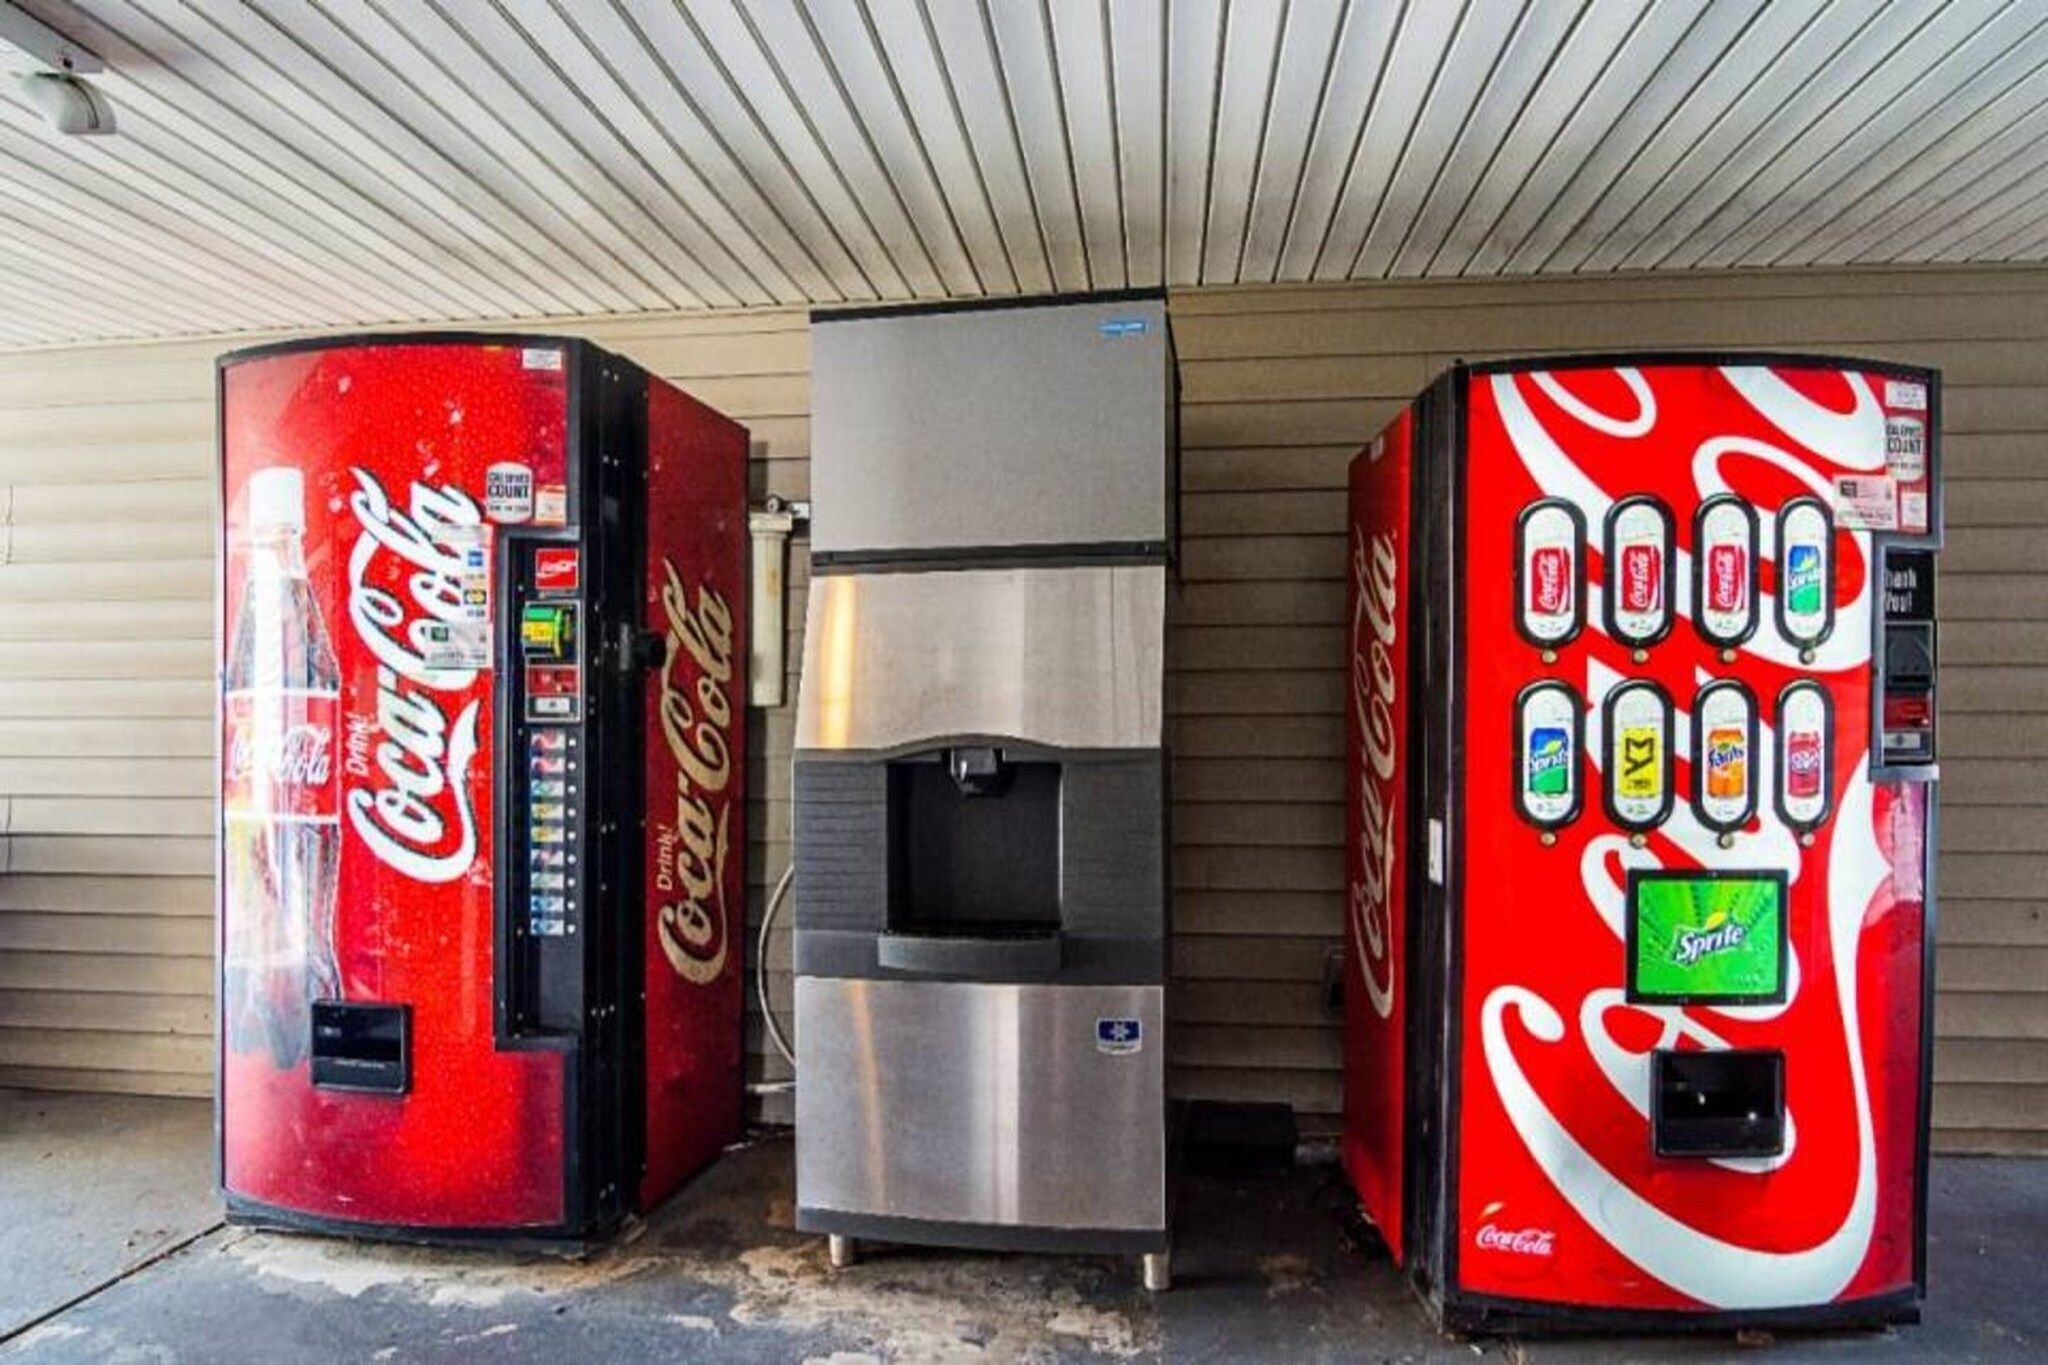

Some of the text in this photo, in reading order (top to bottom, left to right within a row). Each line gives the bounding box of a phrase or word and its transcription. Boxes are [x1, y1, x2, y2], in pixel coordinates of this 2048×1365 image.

[488, 485, 529, 498] COUNT
[657, 825, 679, 891] Drink!
[1676, 923, 1745, 962] Sprite
